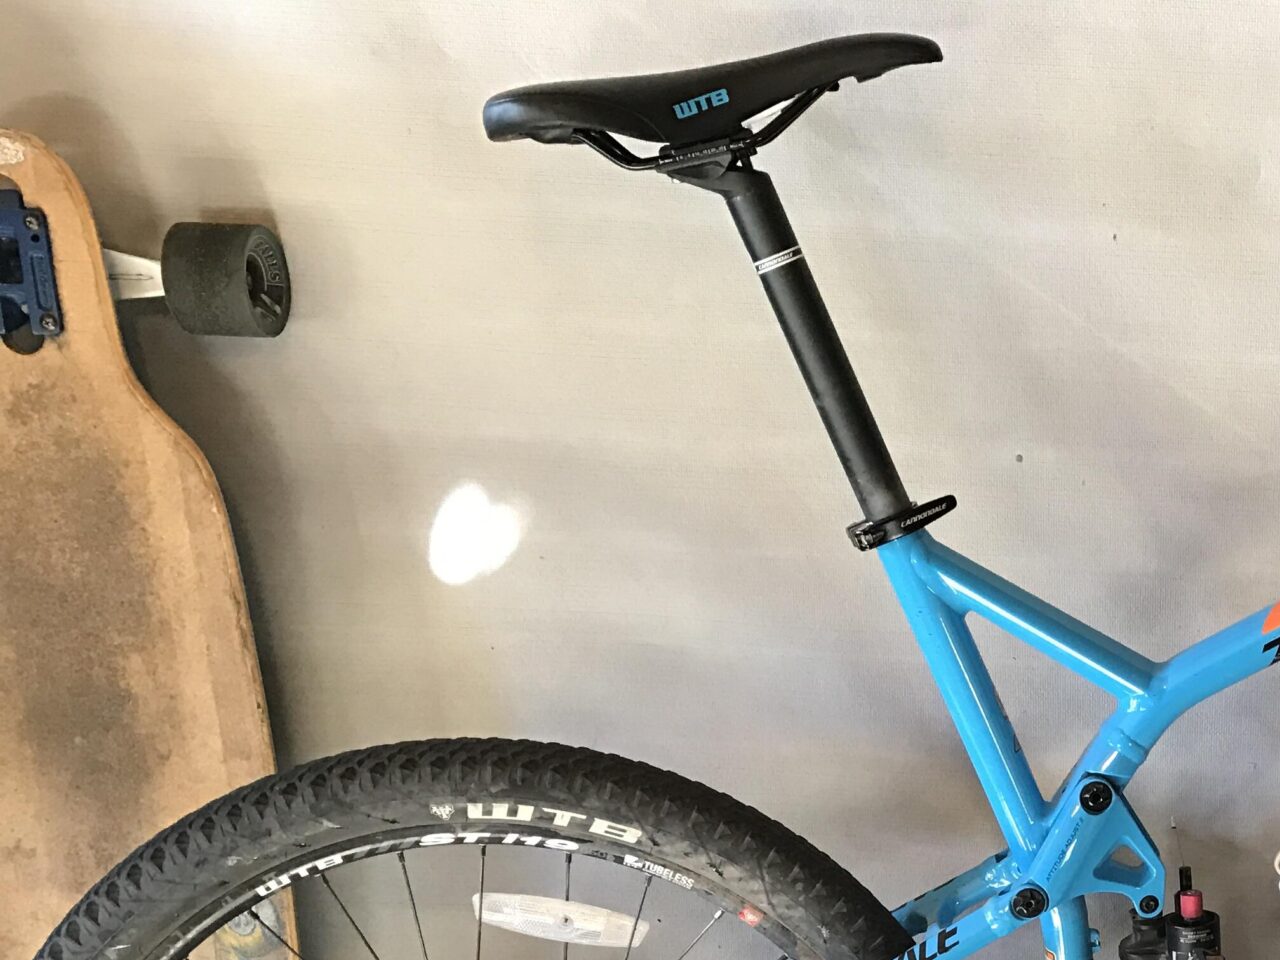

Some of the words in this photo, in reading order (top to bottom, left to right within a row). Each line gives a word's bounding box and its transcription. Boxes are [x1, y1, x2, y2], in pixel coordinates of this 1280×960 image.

[672, 88, 730, 120] WTB
[900, 502, 948, 528] CANNONDALE
[467, 802, 644, 844] WTB
[256, 853, 343, 897] WTB
[642, 858, 695, 890] TUBELESS
